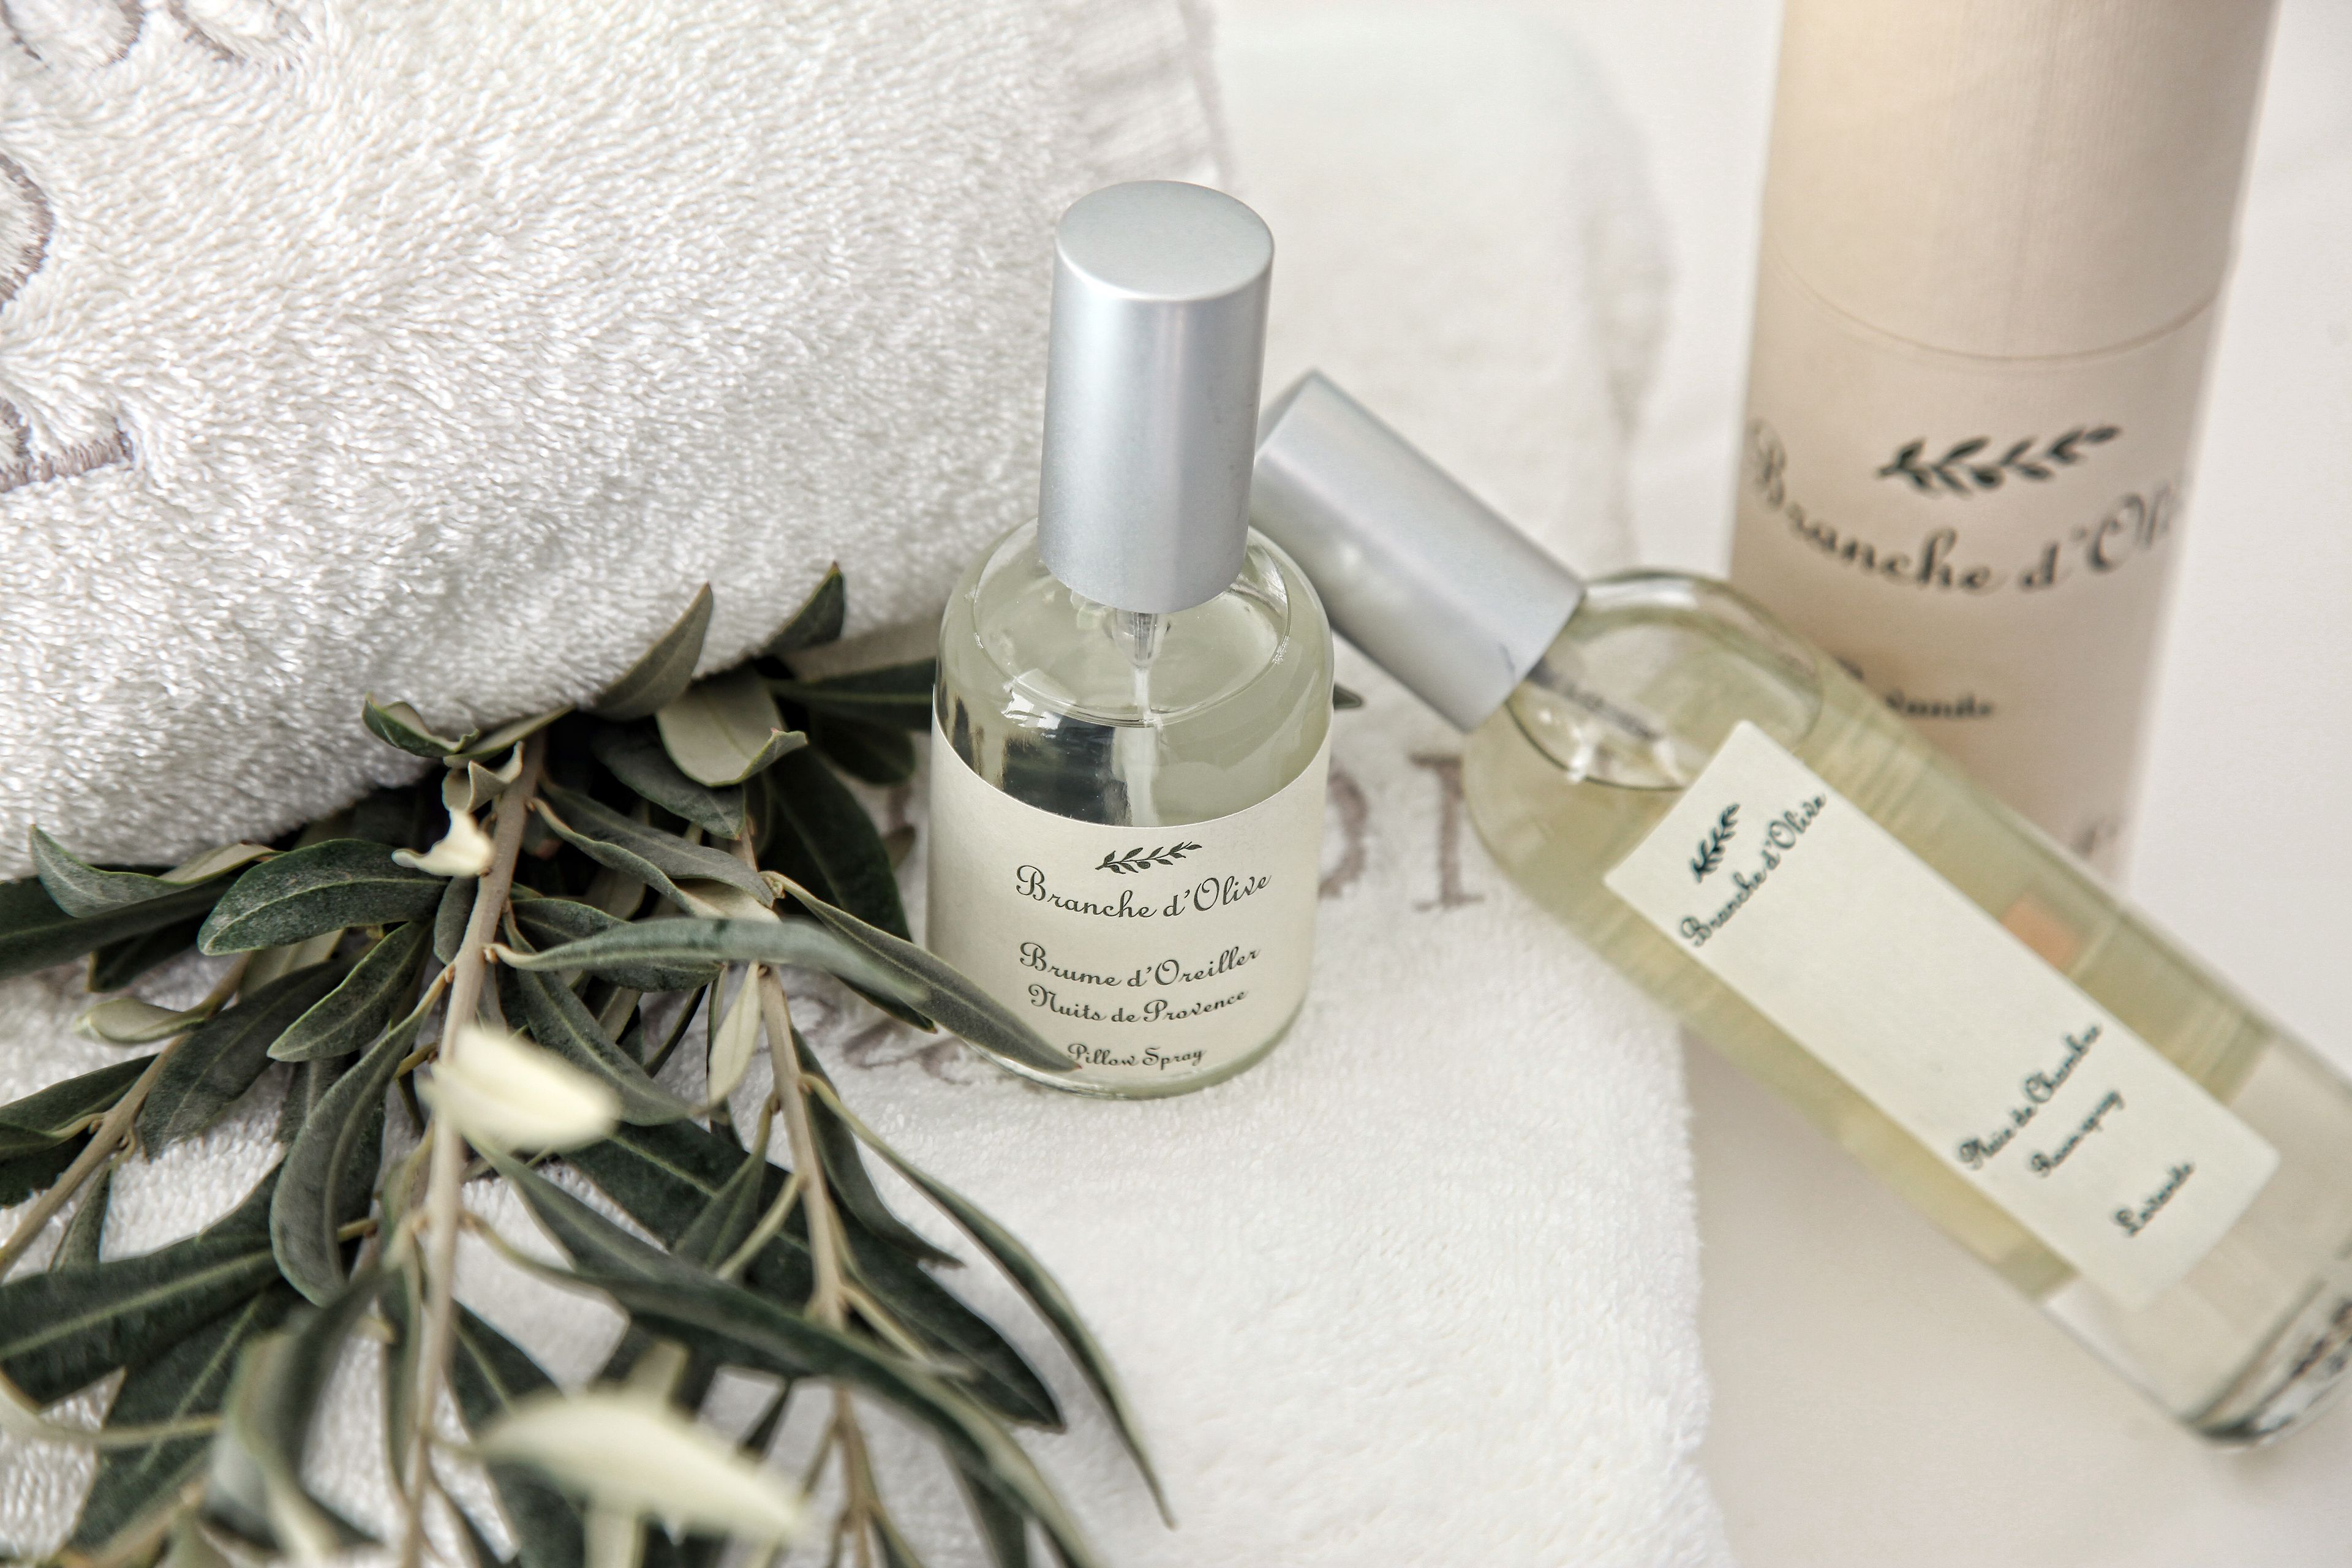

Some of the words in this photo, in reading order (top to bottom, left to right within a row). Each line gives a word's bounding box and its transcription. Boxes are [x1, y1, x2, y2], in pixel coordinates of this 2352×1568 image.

[1748, 418, 2010, 597] Branche
[1016, 864, 1158, 918] Branche
[1162, 874, 1272, 918] d'Olive
[1680, 871, 1766, 948] Branche
[1760, 795, 1826, 870] d'Olive
[1020, 941, 1122, 987] Brume
[1127, 946, 1261, 987] d'Oreiller
[1028, 984, 1105, 1022] Nuits
[1111, 1008, 1140, 1022] de
[1143, 990, 1248, 1022] Provence
[1068, 1043, 1138, 1066] Pillow
[1142, 1047, 1205, 1070] Spray
[2011, 1106, 2036, 1127] de
[2026, 1025, 2101, 1103] Chambre
